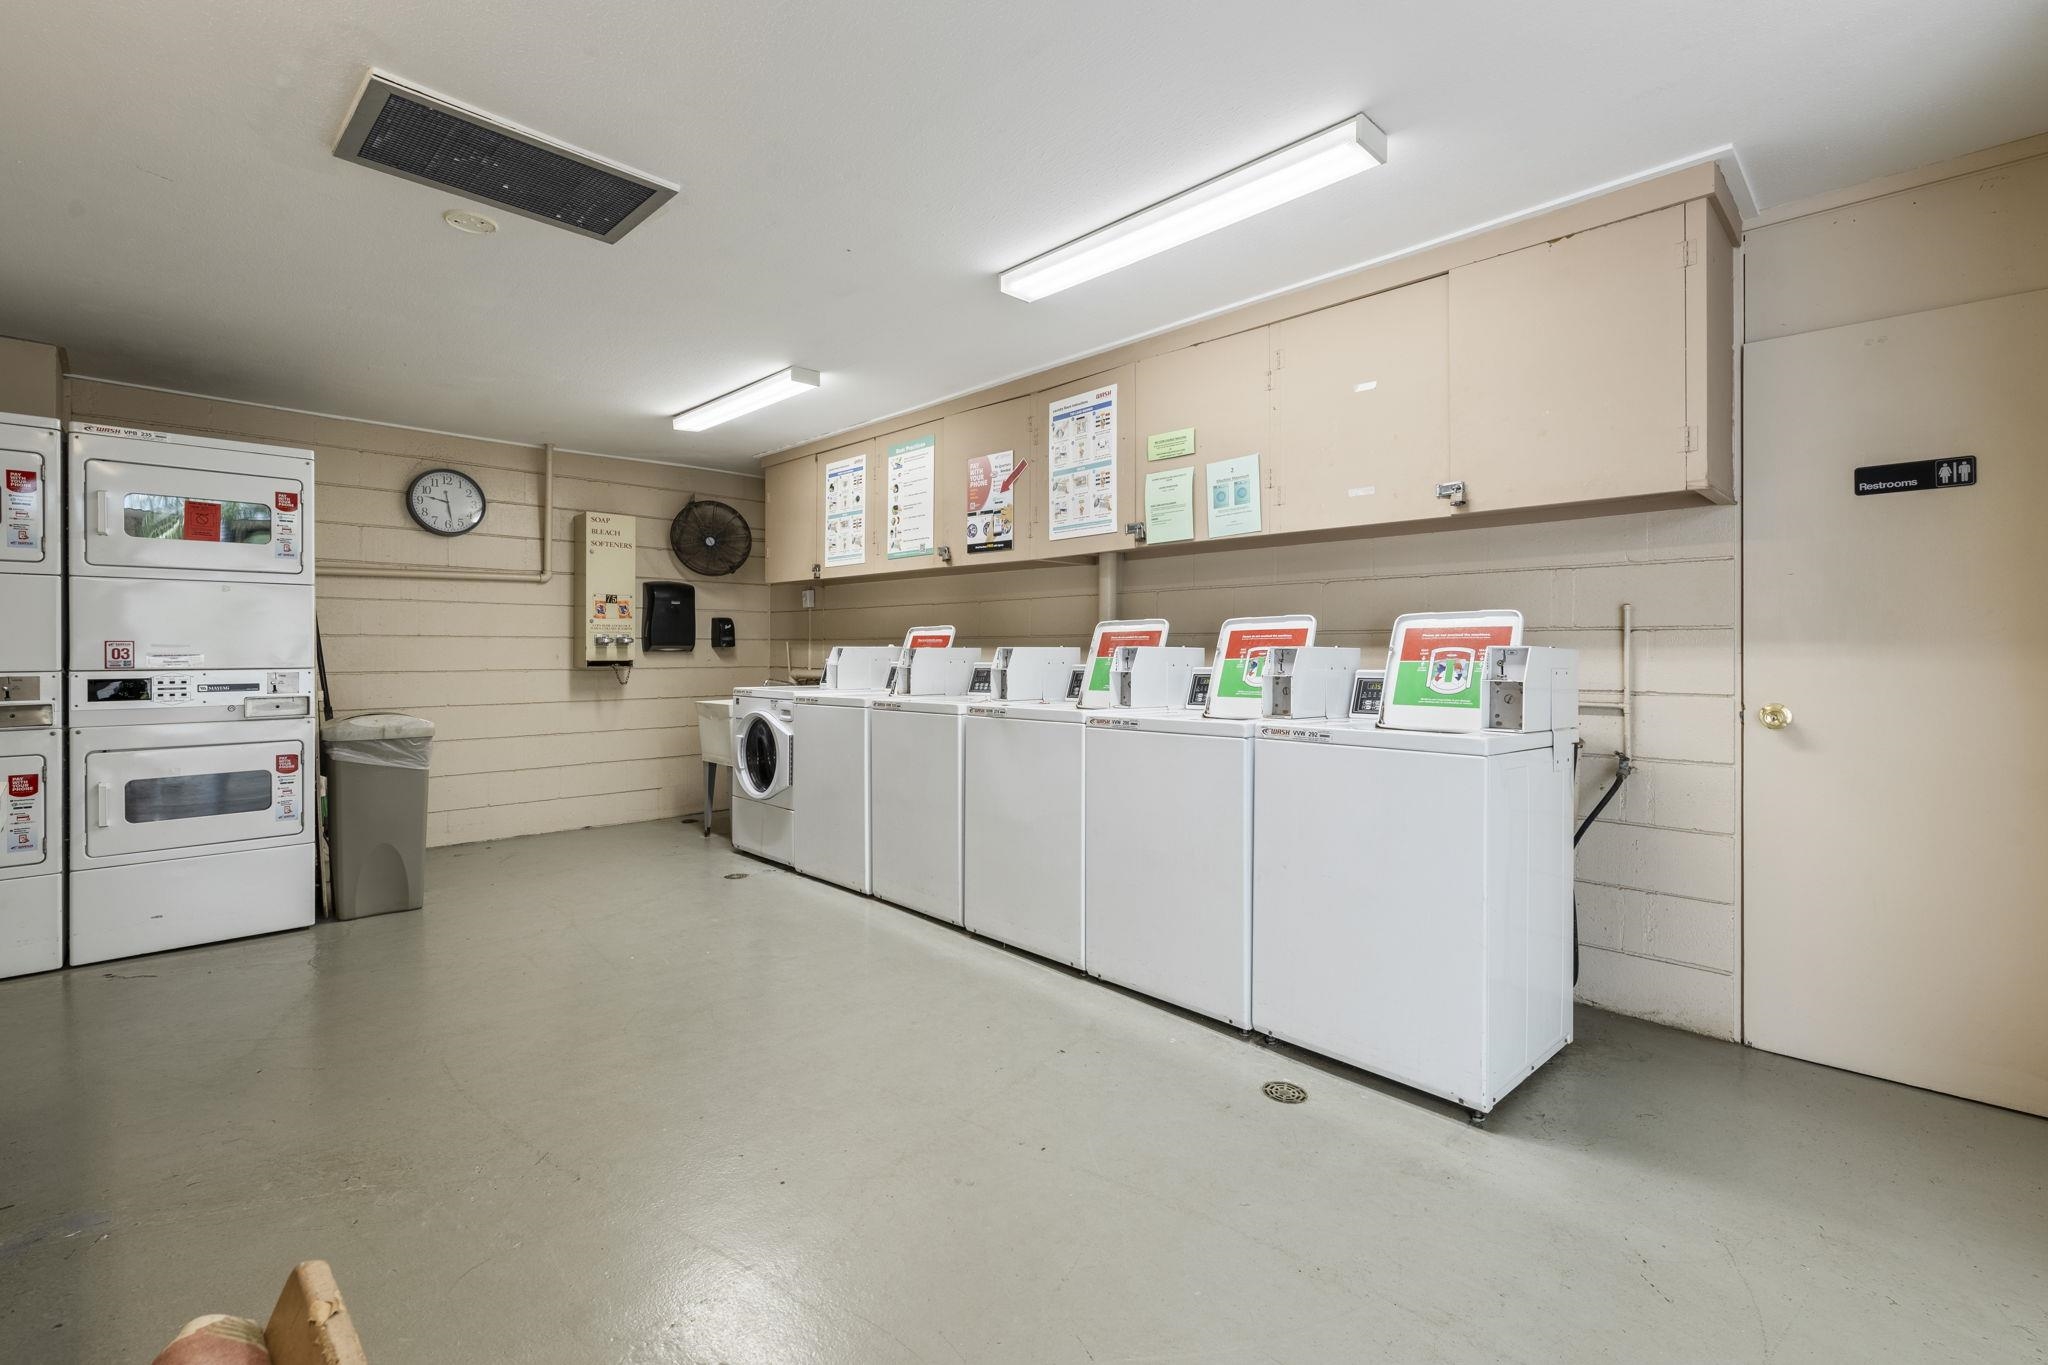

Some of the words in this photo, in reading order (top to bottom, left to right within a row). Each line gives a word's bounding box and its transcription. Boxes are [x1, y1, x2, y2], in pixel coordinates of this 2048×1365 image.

[95, 426, 121, 434] WASH
[442, 476, 453, 485] 12
[970, 474, 984, 482] YOUR
[431, 478, 439, 487] 11
[970, 480, 988, 488] PHONE
[1859, 479, 1918, 491] Restrooms
[422, 486, 431, 494] 10
[591, 529, 621, 537] BLEACH
[591, 540, 633, 550] SOFTENERS
[111, 648, 130, 660] 03
[1270, 728, 1290, 736] WASH
